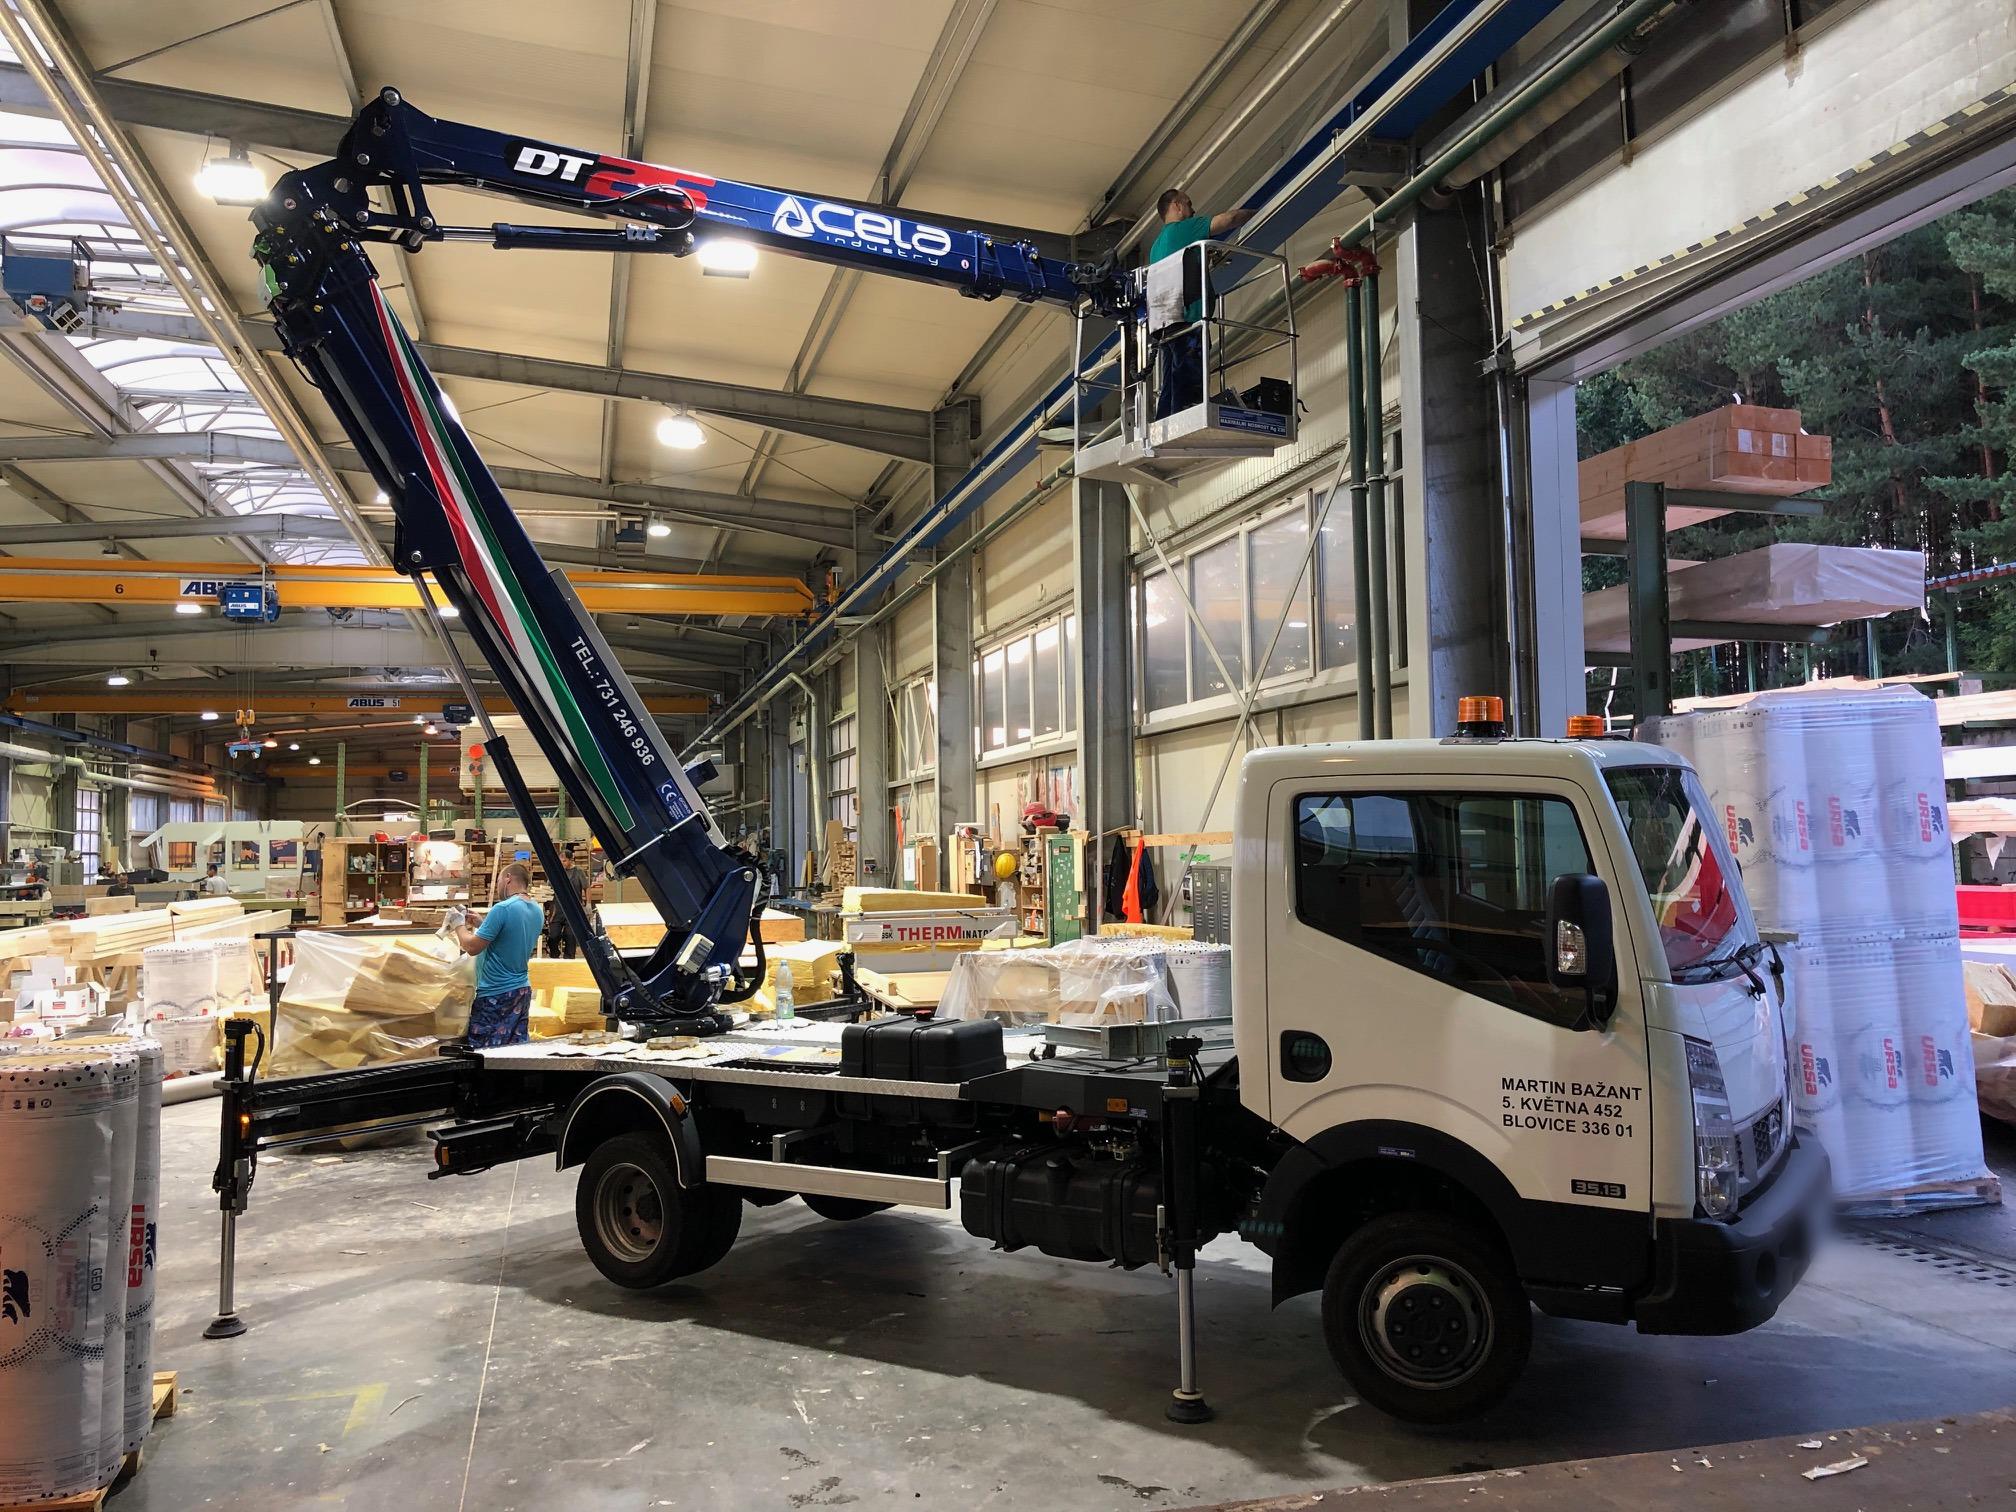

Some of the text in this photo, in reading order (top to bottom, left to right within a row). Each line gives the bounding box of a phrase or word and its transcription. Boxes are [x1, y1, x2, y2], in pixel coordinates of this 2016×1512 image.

[826, 236, 939, 266] industry
[115, 583, 124, 594] 6
[349, 698, 385, 707] ABUS
[571, 636, 655, 766] TEL.: 731 246 936
[897, 925, 994, 941] THERMINATO
[1501, 1077, 1642, 1101] MARTIN BAŽANT
[1502, 1096, 1623, 1118] 5. KVĚTNA 452
[1503, 1114, 1633, 1138] BLOVICE 336 01
[1575, 1181, 1622, 1196] 35.13
[90, 1267, 103, 1292] GEO
